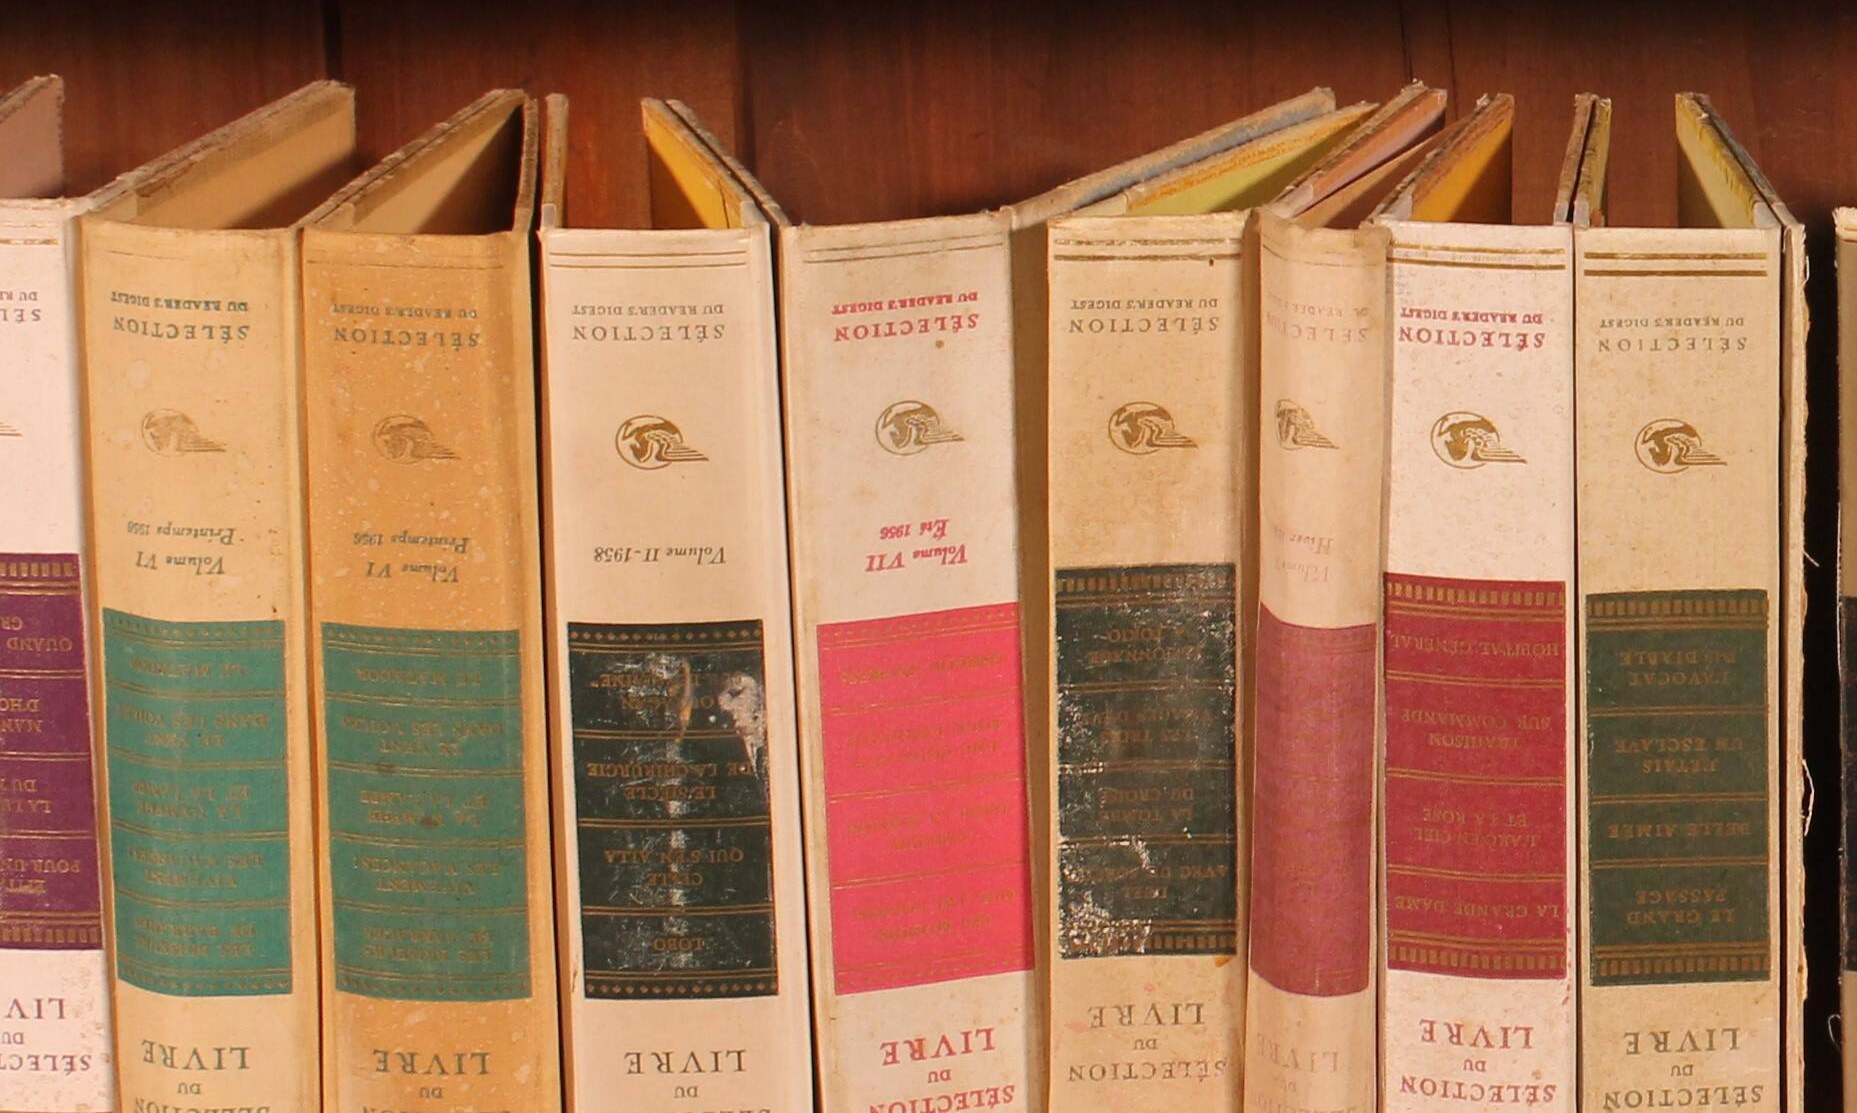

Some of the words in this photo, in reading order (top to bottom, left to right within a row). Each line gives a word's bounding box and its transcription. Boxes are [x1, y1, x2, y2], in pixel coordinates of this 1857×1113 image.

[17, 290, 38, 303] DU
[109, 291, 151, 308] DIGEST
[153, 297, 222, 312] READER'S
[886, 293, 954, 311] READER'S
[957, 291, 978, 304] DU
[1069, 299, 1122, 311] DIGEST
[1125, 299, 1193, 311] READER'S
[1197, 298, 1218, 310] DU
[226, 300, 248, 313] DU
[330, 302, 380, 317] DIGEST
[384, 305, 452, 319] READER'S
[458, 308, 478, 320] DU
[571, 304, 623, 317] DIGEST
[627, 304, 698, 317] READER'S
[702, 303, 724, 316] DU
[830, 300, 884, 316] DIGEST
[1399, 306, 1448, 321] DIGEST
[1068, 316, 1220, 335] SÉLECTION
[1451, 310, 1518, 325] READER'S
[1522, 312, 1543, 325] DU
[1598, 317, 1650, 329] DIGEST
[1654, 316, 1720, 328] READER'S
[1725, 316, 1745, 327] DU
[111, 316, 250, 344] SÉLECTION
[571, 323, 725, 343] SÉLECTION
[832, 312, 979, 343] SÉLECTION
[333, 327, 480, 353] SÉLECTION
[1398, 325, 1546, 352] SÉLECTION
[1598, 336, 1748, 355] SÉLECTION
[156, 522, 237, 547] Printemps
[879, 523, 913, 541] 1956
[919, 518, 950, 542] Été
[390, 530, 471, 555] Printemps
[135, 550, 158, 571] VI
[665, 546, 727, 566] Volume
[864, 550, 906, 573] VII
[911, 543, 968, 566] Volume
[165, 555, 225, 576] Volume
[366, 561, 393, 579] VI
[400, 563, 460, 584] Volume
[585, 762, 690, 778] CHIRURGIE
[707, 846, 745, 863] QUI
[1087, 1001, 1205, 1030] LIVRE
[1418, 1018, 1534, 1049] LIVRE
[1622, 1026, 1741, 1056] LIVRE
[878, 1026, 995, 1066] LIVRE
[1132, 1037, 1158, 1051] DU
[140, 1038, 251, 1072] LIVRE
[371, 1048, 491, 1076] LIVRE
[623, 1048, 747, 1075] LIVRE
[1067, 1059, 1228, 1083] SÉLECTION
[1462, 1058, 1487, 1073] DU
[1670, 1063, 1694, 1077] DU
[926, 1068, 952, 1084] DU
[176, 1081, 202, 1096] DU
[418, 1086, 444, 1100] DU
[673, 1085, 699, 1100] DU
[1398, 1074, 1557, 1107] SÉLECTION
[1602, 1084, 1765, 1108] SÉLECTION
